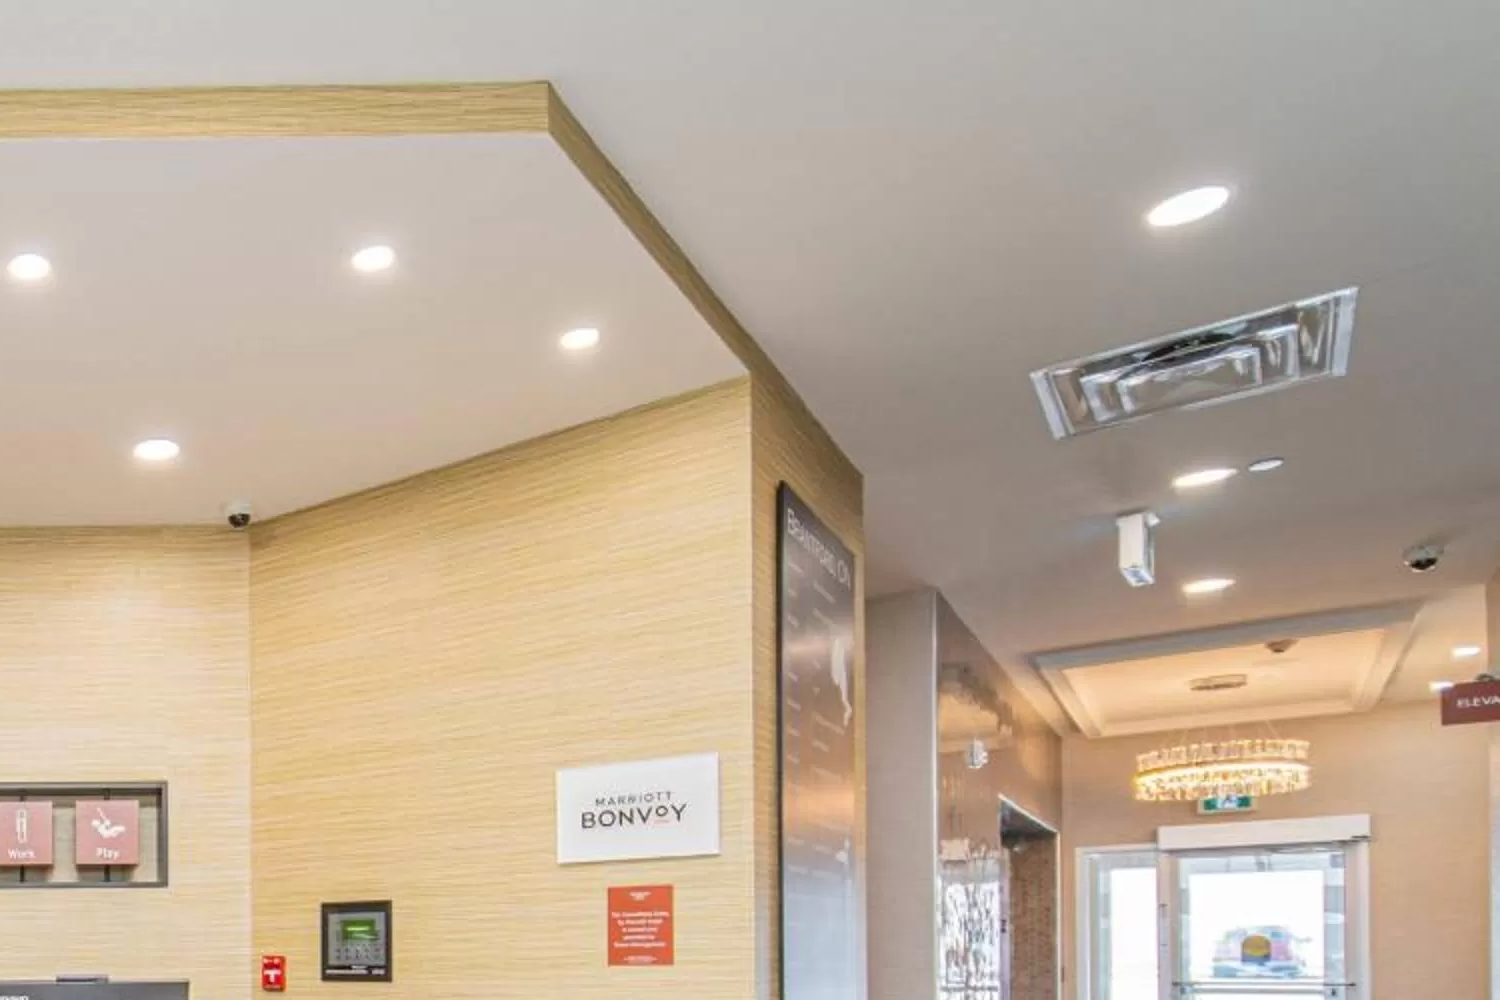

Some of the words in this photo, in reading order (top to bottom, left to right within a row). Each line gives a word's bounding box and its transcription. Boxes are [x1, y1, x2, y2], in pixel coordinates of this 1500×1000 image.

[595, 791, 673, 806] MARRIOTT
[7, 848, 35, 860] Work
[96, 847, 120, 860] Play
